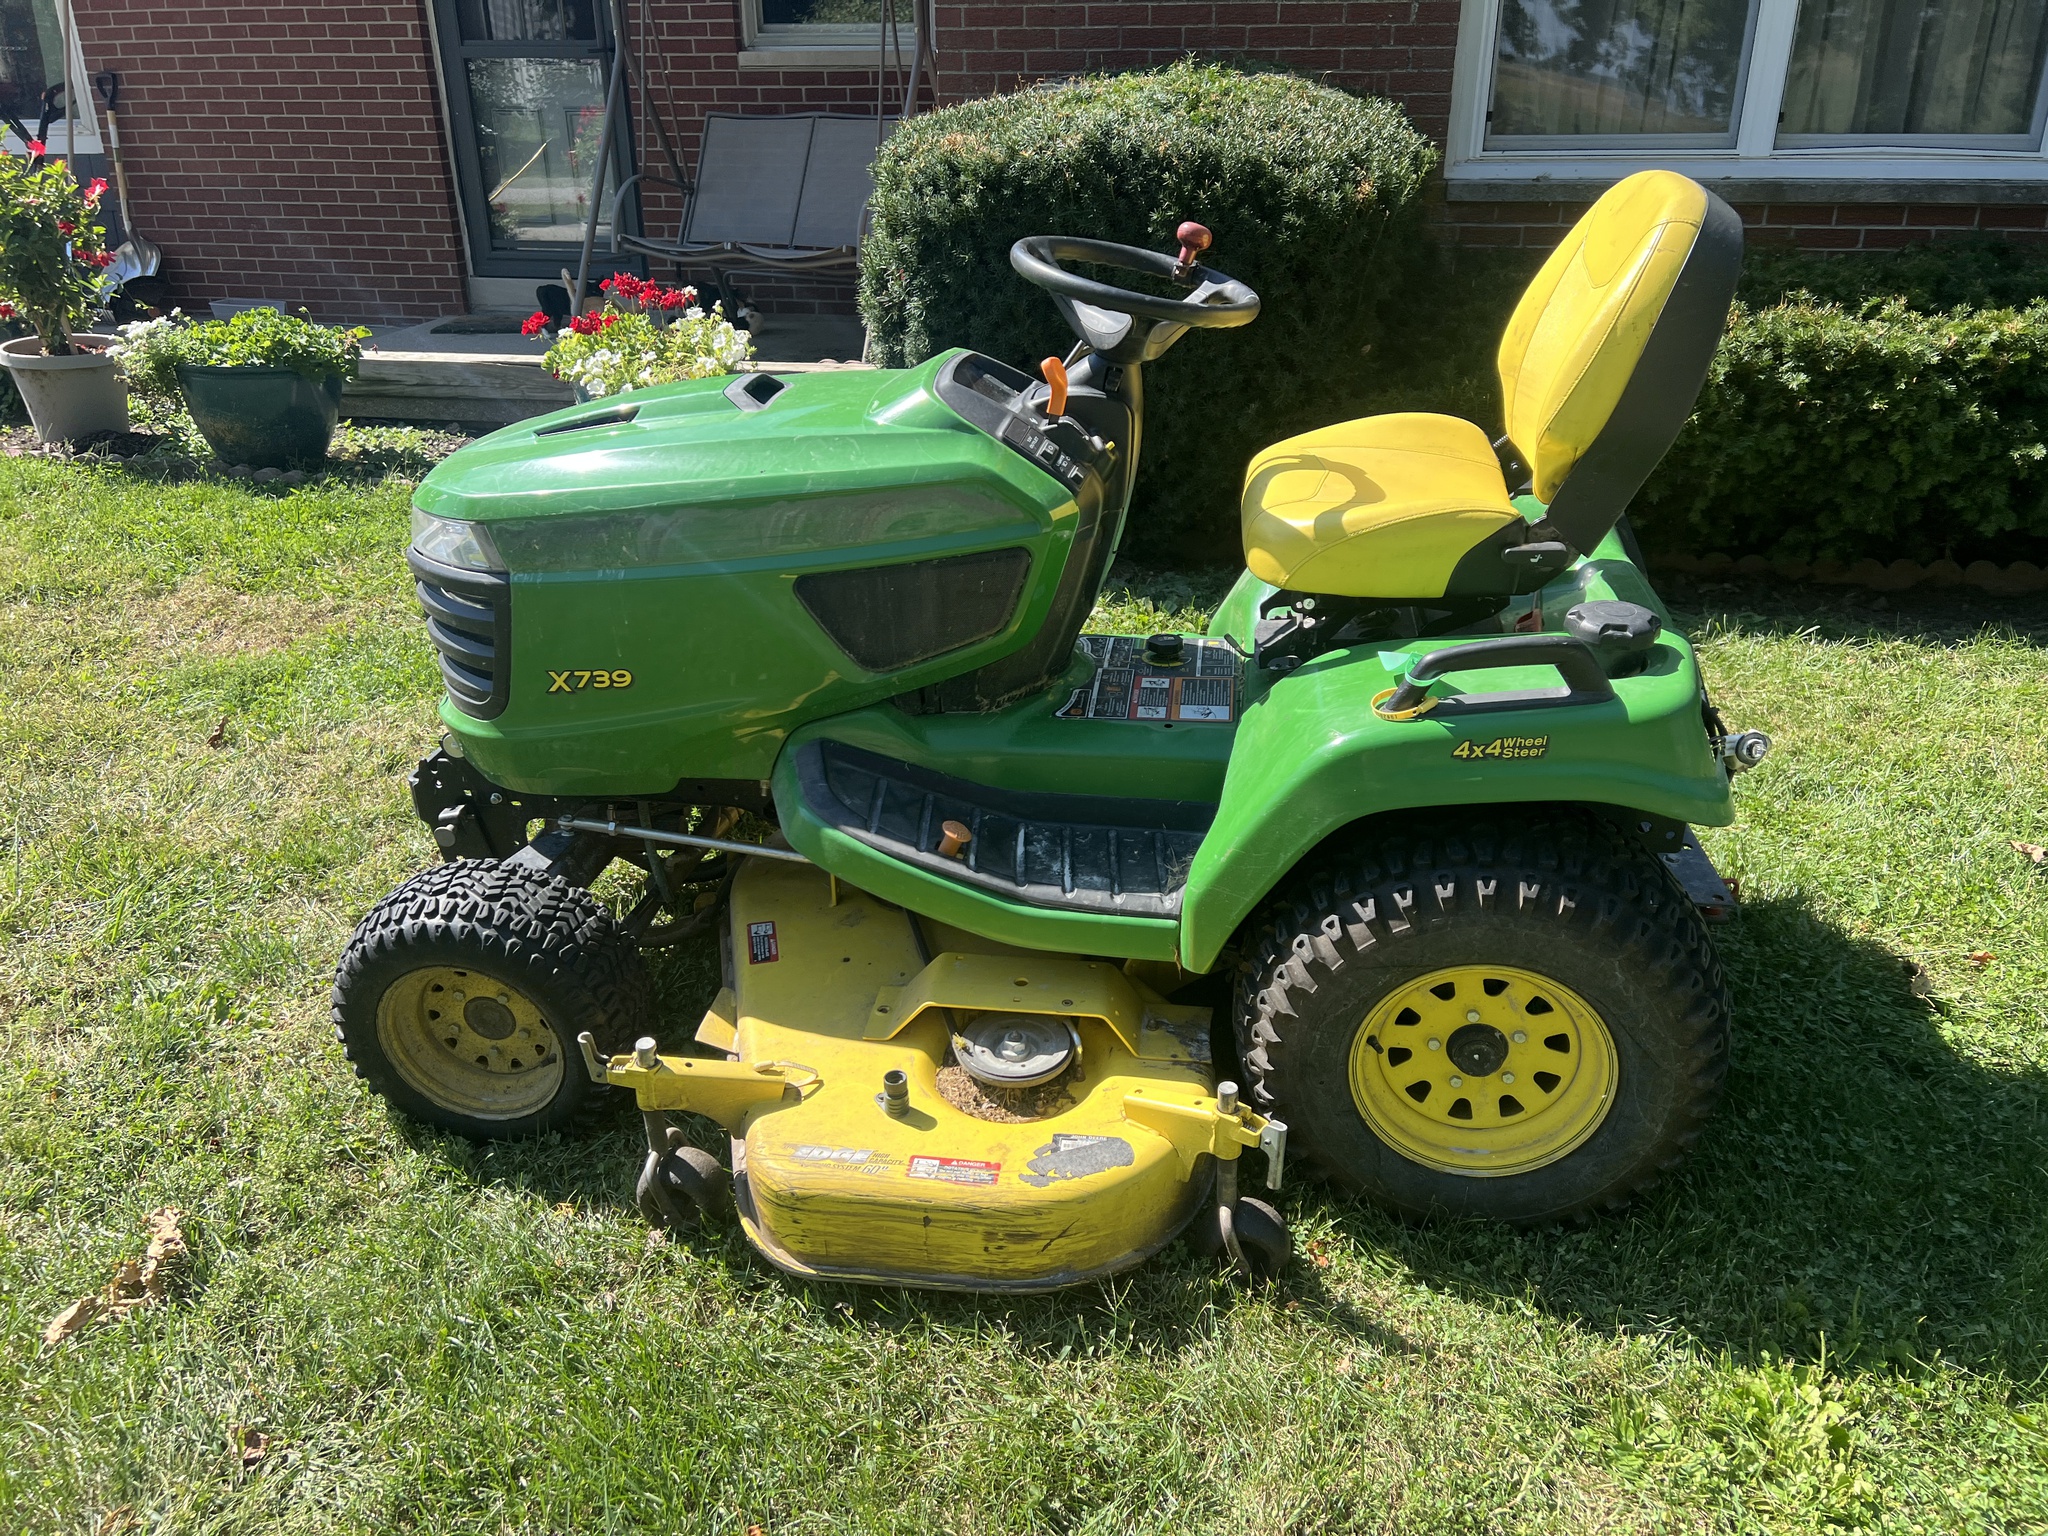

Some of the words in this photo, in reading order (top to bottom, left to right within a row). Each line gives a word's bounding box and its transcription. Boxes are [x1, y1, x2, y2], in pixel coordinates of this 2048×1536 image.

[546, 668, 633, 693] X739
[1452, 739, 1502, 758] 4x4
[1503, 735, 1548, 748] Wheel
[1502, 747, 1545, 758] Steer
[792, 1144, 873, 1165] EDGE
[868, 1157, 904, 1166] CAPACITY
